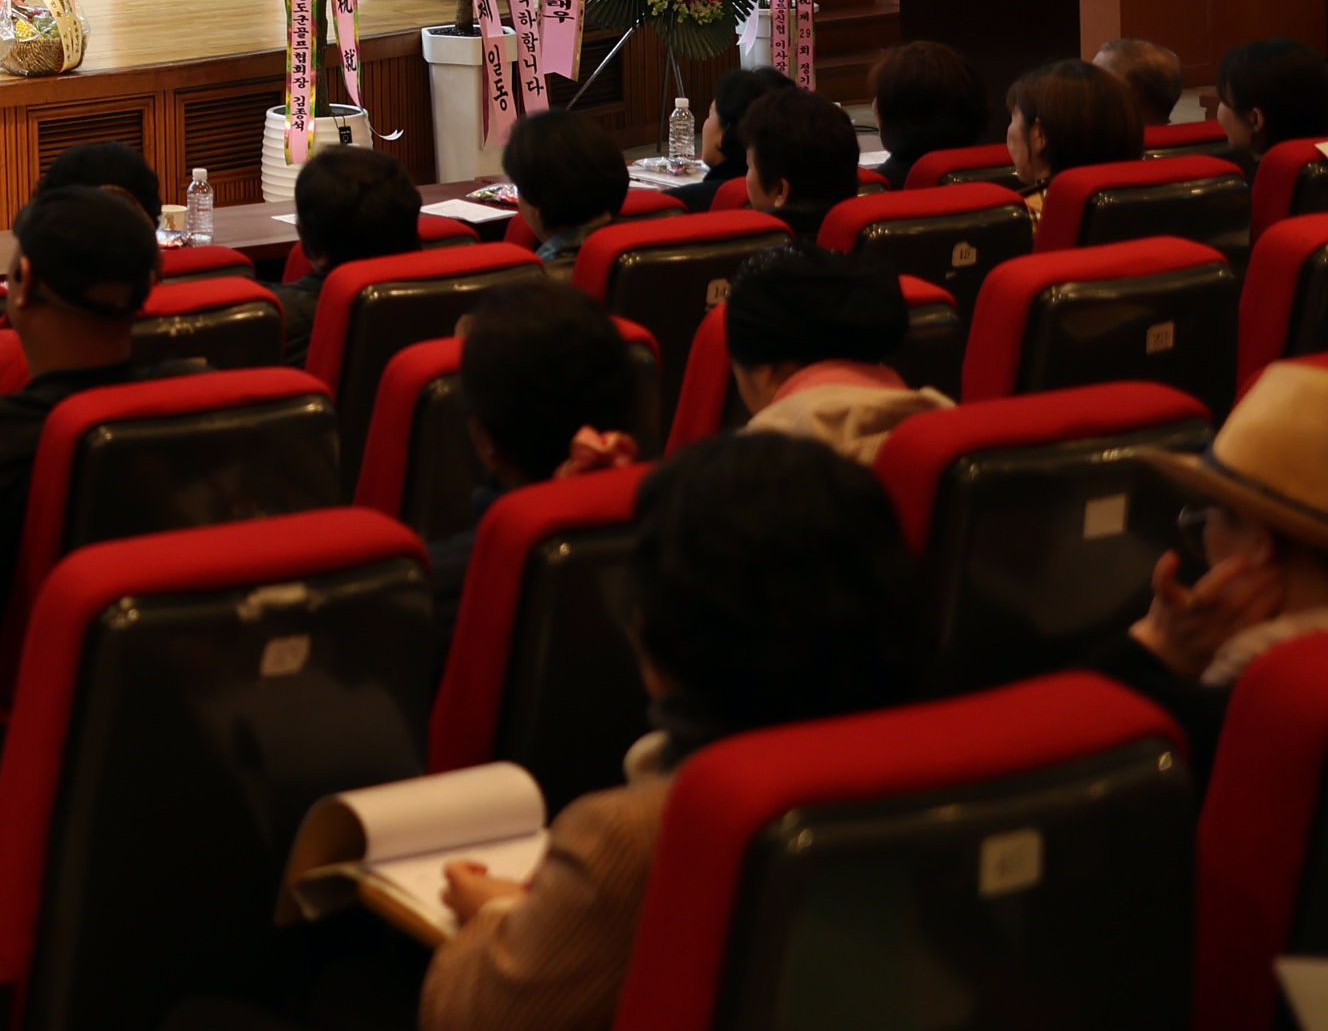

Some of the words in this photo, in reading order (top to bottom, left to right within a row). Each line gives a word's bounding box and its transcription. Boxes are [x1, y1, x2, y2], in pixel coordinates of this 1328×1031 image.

[775, 41, 788, 72] 이사장
[487, 43, 509, 112] 일동
[799, 62, 811, 89] 정기
[291, 95, 308, 133] 김종석
